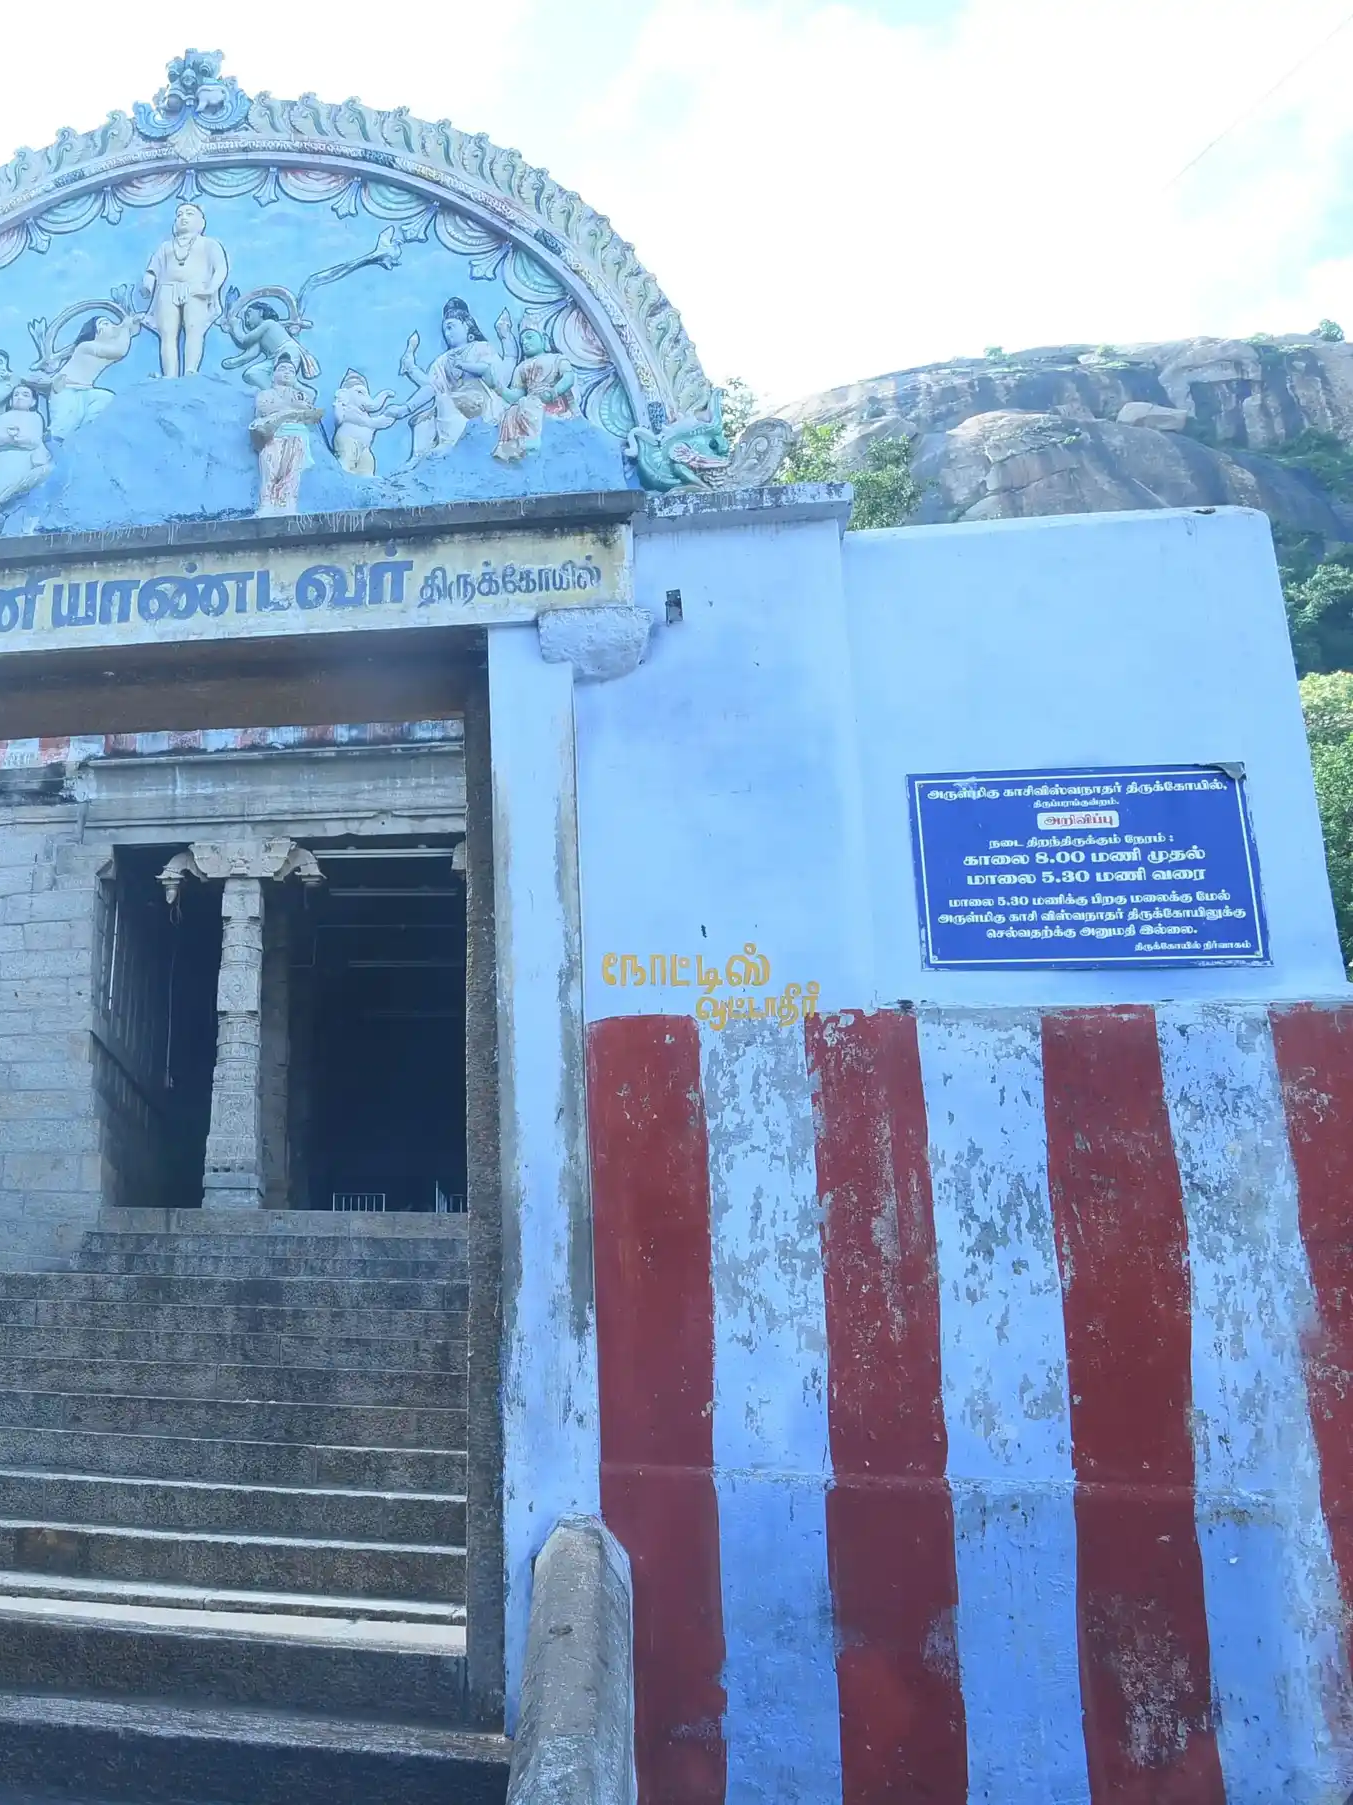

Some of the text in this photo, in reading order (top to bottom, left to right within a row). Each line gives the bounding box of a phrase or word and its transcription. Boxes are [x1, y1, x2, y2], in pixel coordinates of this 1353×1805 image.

[416, 554, 602, 608] திருக்கோயில்
[927, 786, 1000, 801] அருள்மிகு
[1044, 813, 1113, 827] அறிவிப்பு
[989, 839, 1024, 850] நடை
[1026, 833, 1121, 848] திறந்திருக்கும்
[1124, 832, 1166, 844] நேரம்
[963, 845, 1206, 866] காலை 8.00 மணி முதல்
[966, 867, 1206, 886] மாலை 5.30 மணி வரை
[949, 889, 1231, 908] மாலை 5.30 மணிக்கு பிறகு மலைக்கு மேல்
[937, 911, 1006, 925] அருள்மிகு
[1009, 910, 1038, 922] காசி
[1079, 924, 1136, 939] அனுமதி
[1134, 941, 1202, 951] திருக்கோயில்
